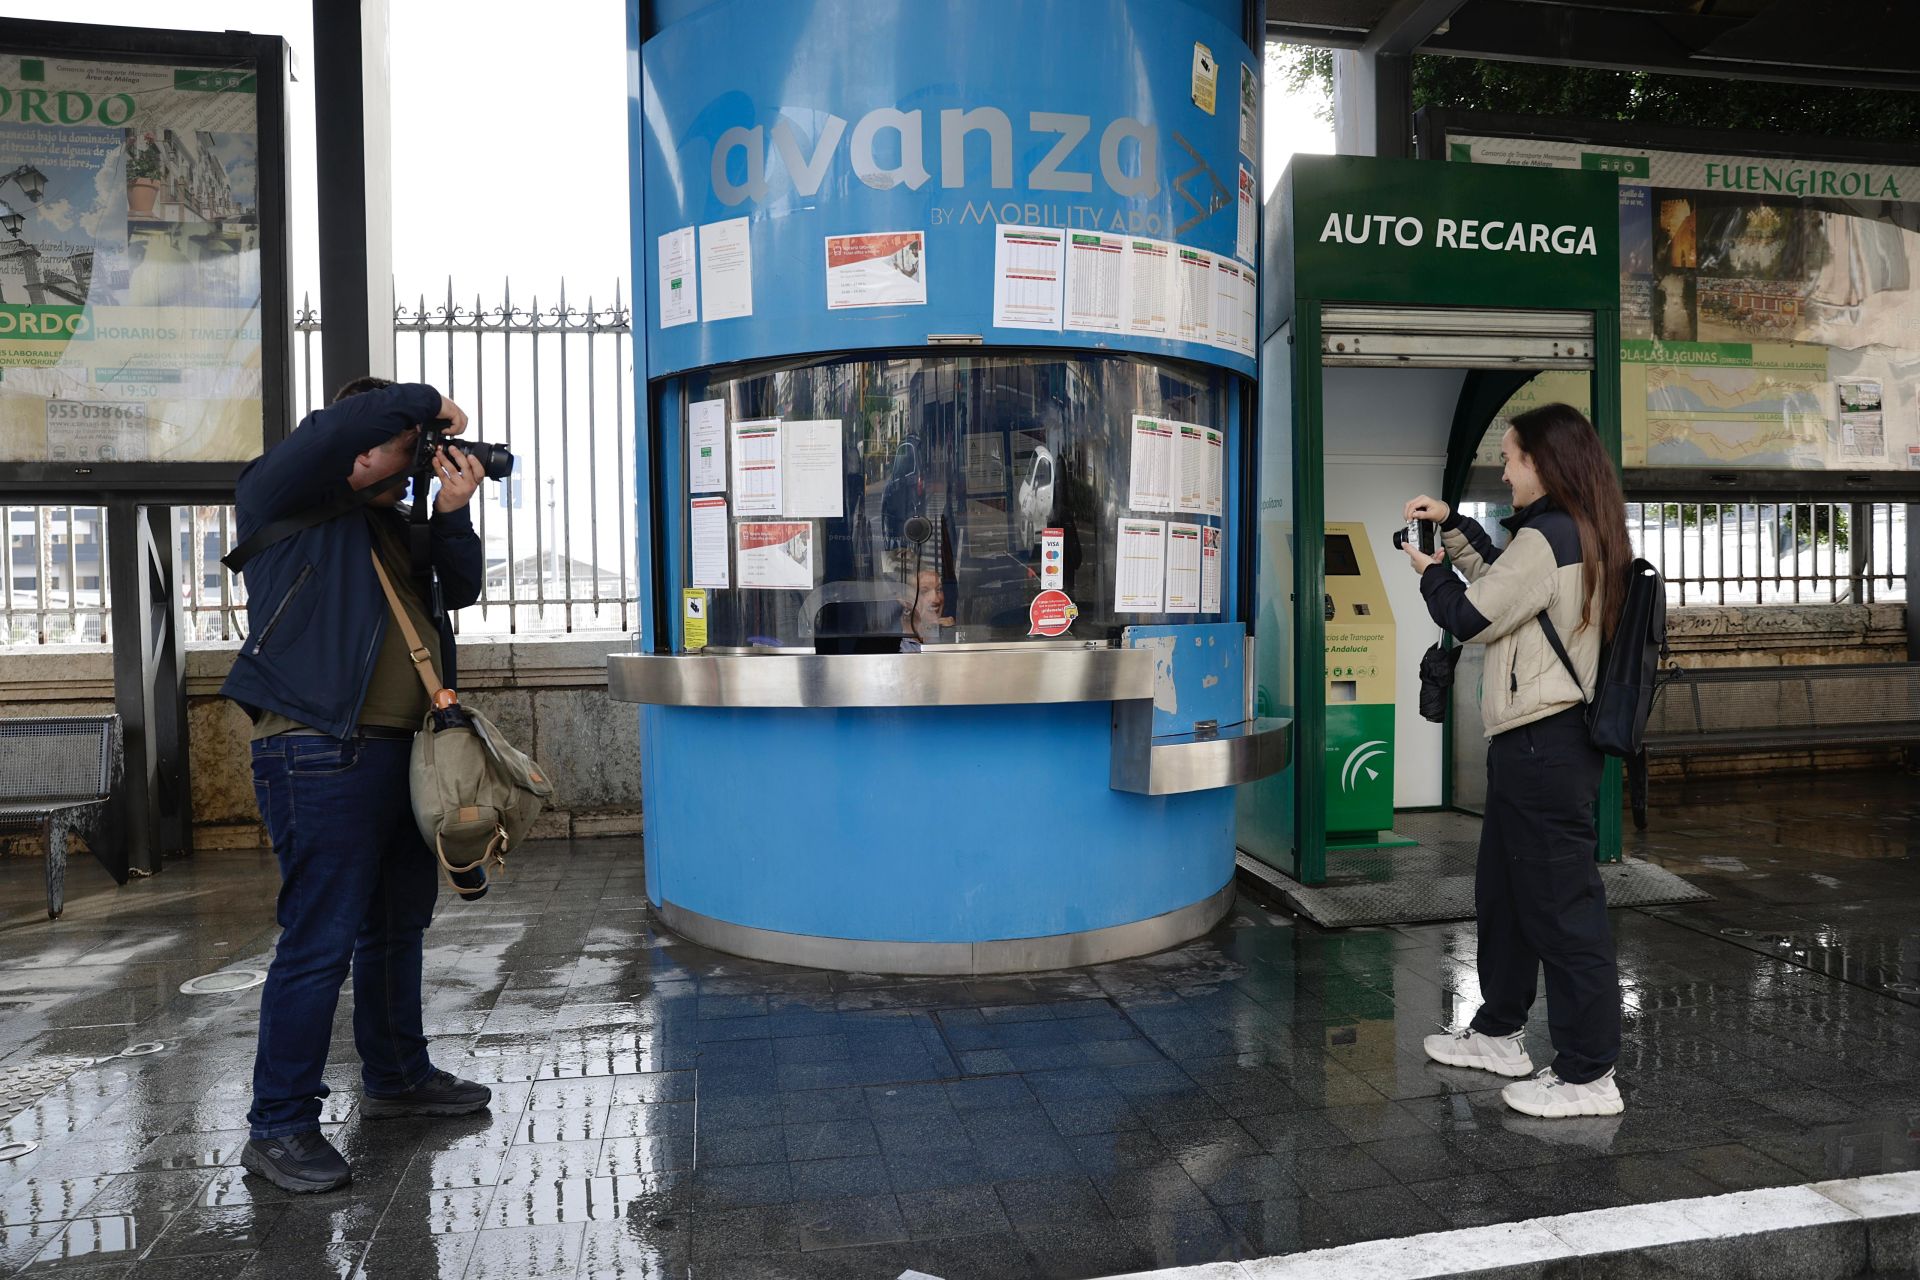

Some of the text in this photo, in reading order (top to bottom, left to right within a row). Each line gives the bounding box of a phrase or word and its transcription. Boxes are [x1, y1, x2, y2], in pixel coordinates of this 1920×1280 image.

[711, 106, 1161, 207] avanza
[1705, 162, 1902, 199] FUENGIROLA
[930, 200, 1162, 234] BY MOBILITY ADO
[1319, 212, 1598, 256] AUTO RECARGA
[0, 312, 89, 334] ORDO
[97, 327, 177, 341] HORARIOS
[8, 350, 63, 359] LABORABLES
[1664, 350, 1718, 364] LAGUNAS
[120, 384, 157, 397] 19:50
[49, 404, 79, 418] 955
[1340, 633, 1349, 641] de
[1350, 633, 1385, 642] Transporte
[1331, 645, 1368, 653] Andalucía
